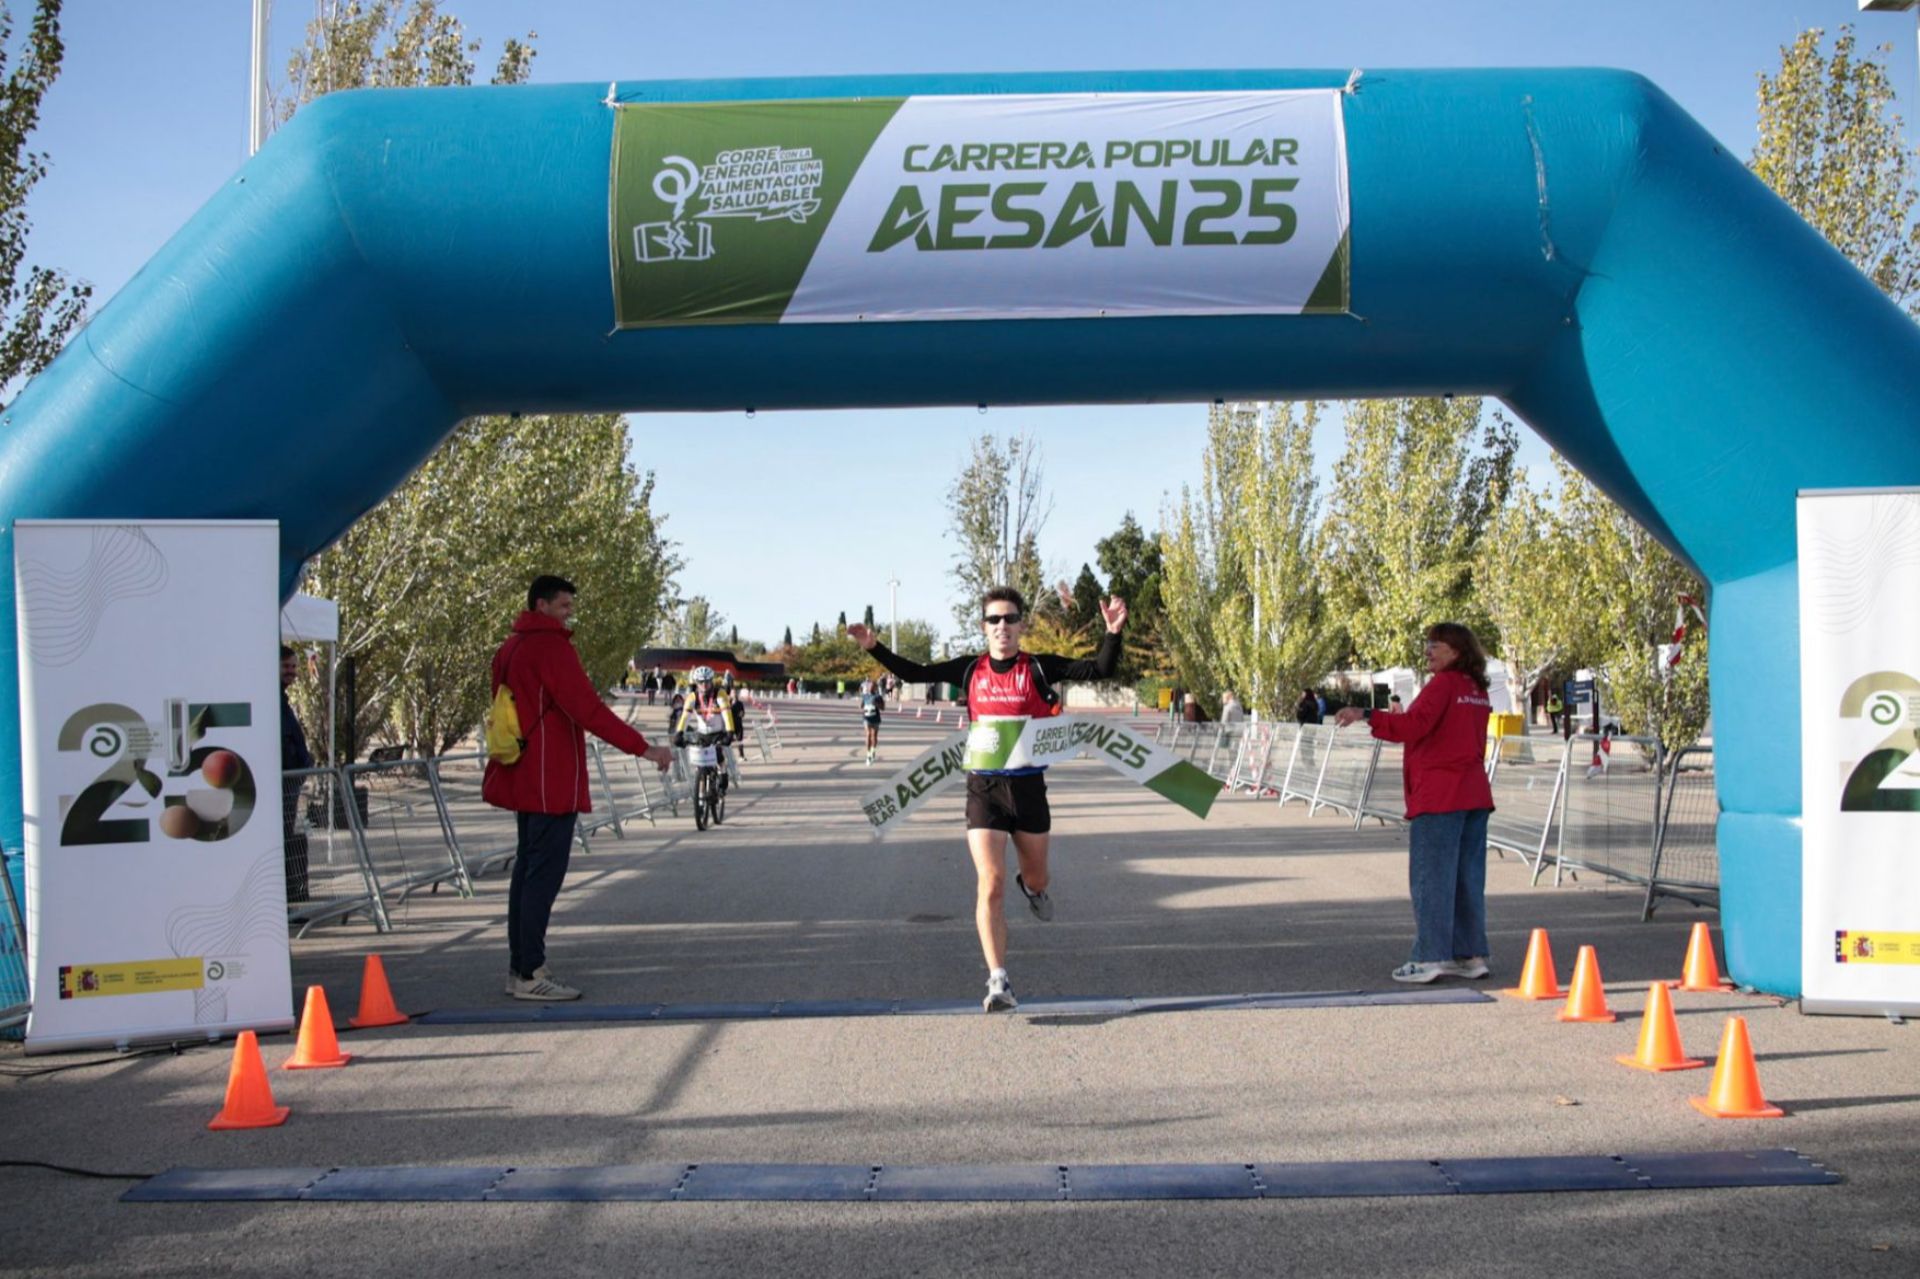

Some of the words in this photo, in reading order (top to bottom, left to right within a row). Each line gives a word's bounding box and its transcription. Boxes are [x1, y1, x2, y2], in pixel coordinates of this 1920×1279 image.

[718, 148, 777, 165] CORRE
[780, 150, 798, 159] CON
[799, 149, 811, 158] LA
[784, 163, 797, 173] DE
[800, 161, 820, 172] UNA
[902, 141, 1095, 172] CARRERA
[1103, 138, 1299, 168] POPULAR
[711, 187, 812, 211] SALUDABLE
[866, 178, 1300, 253] AESAN25
